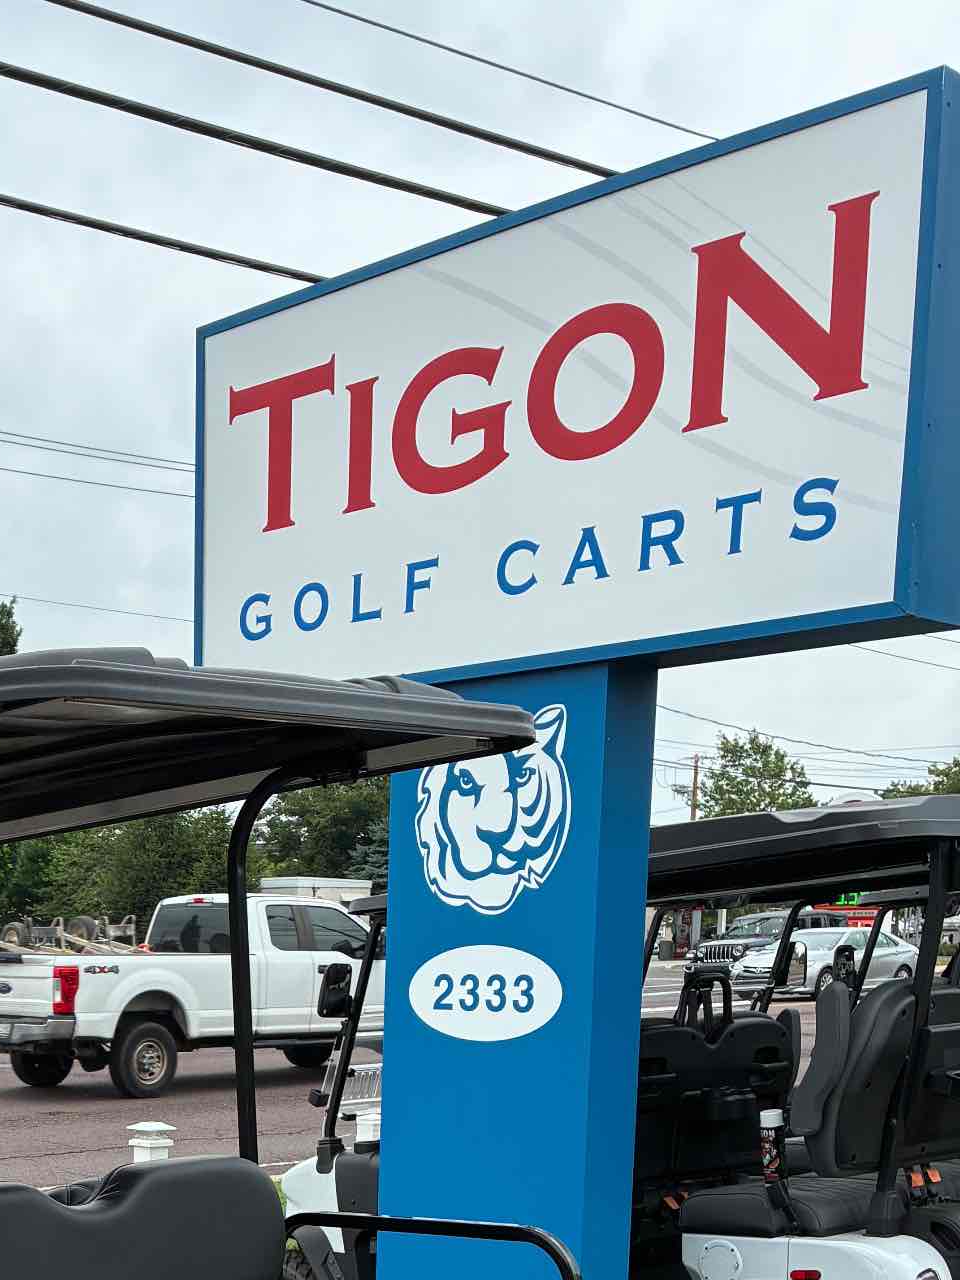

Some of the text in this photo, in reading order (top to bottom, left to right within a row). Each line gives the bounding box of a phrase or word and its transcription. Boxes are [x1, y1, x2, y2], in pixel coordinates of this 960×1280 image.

[228, 191, 880, 532] TIGON
[239, 477, 840, 641] GOLF CARTS
[432, 973, 535, 1014] 2333
